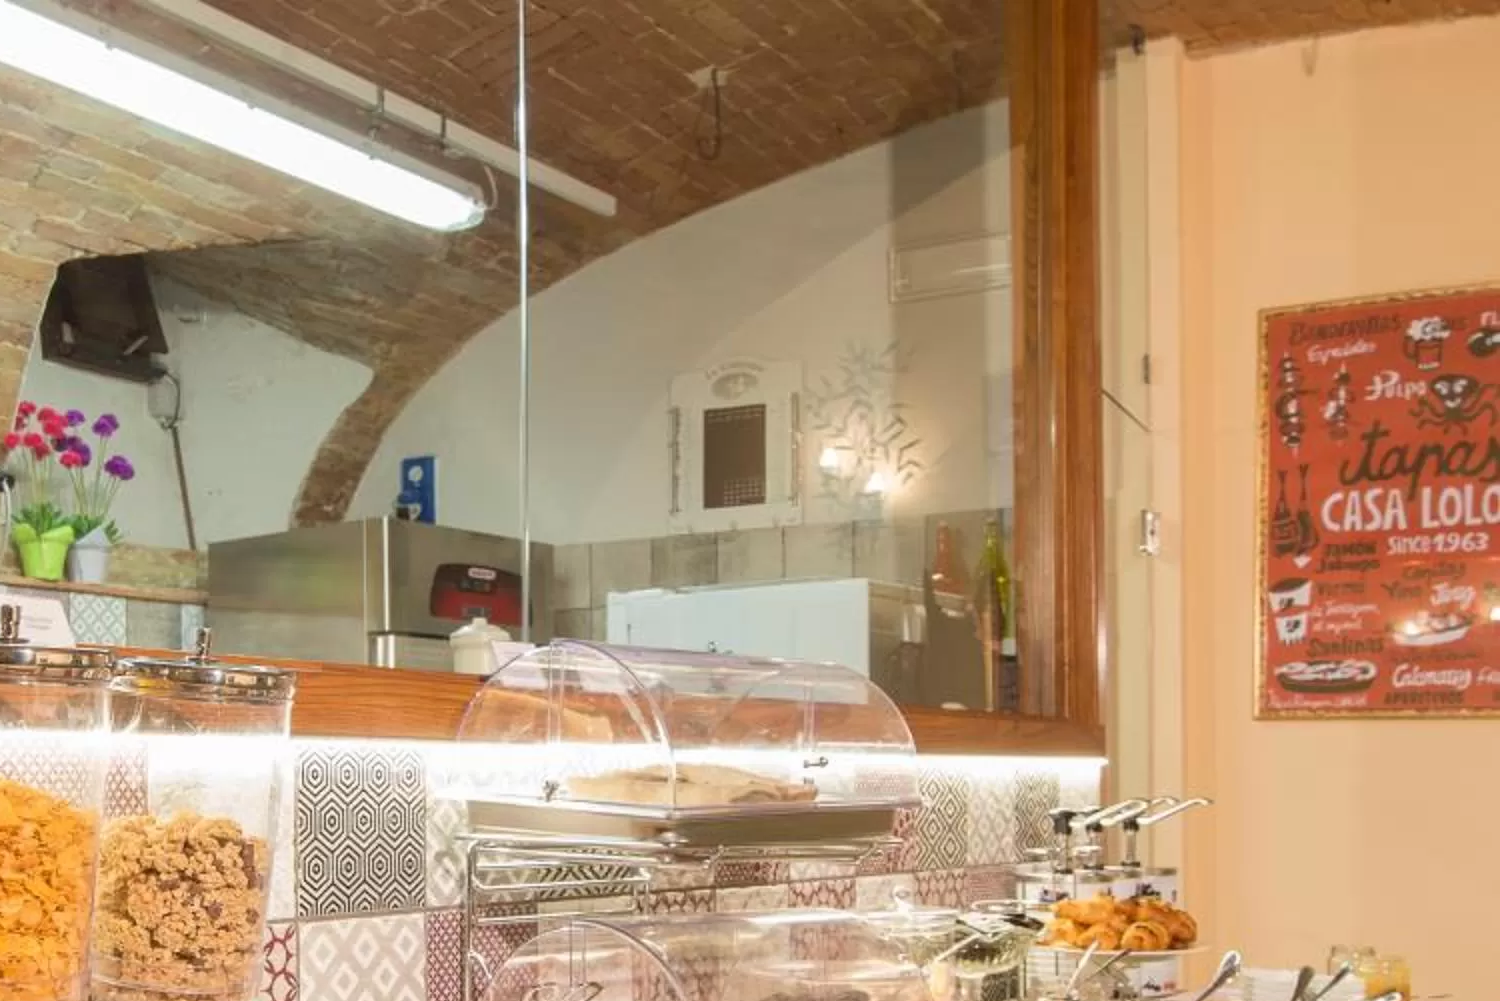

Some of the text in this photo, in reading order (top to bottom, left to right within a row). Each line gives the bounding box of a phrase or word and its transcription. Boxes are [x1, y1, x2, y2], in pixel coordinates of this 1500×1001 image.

[1321, 482, 1500, 532] CASA LOLO
[1432, 531, 1490, 553] 1963
